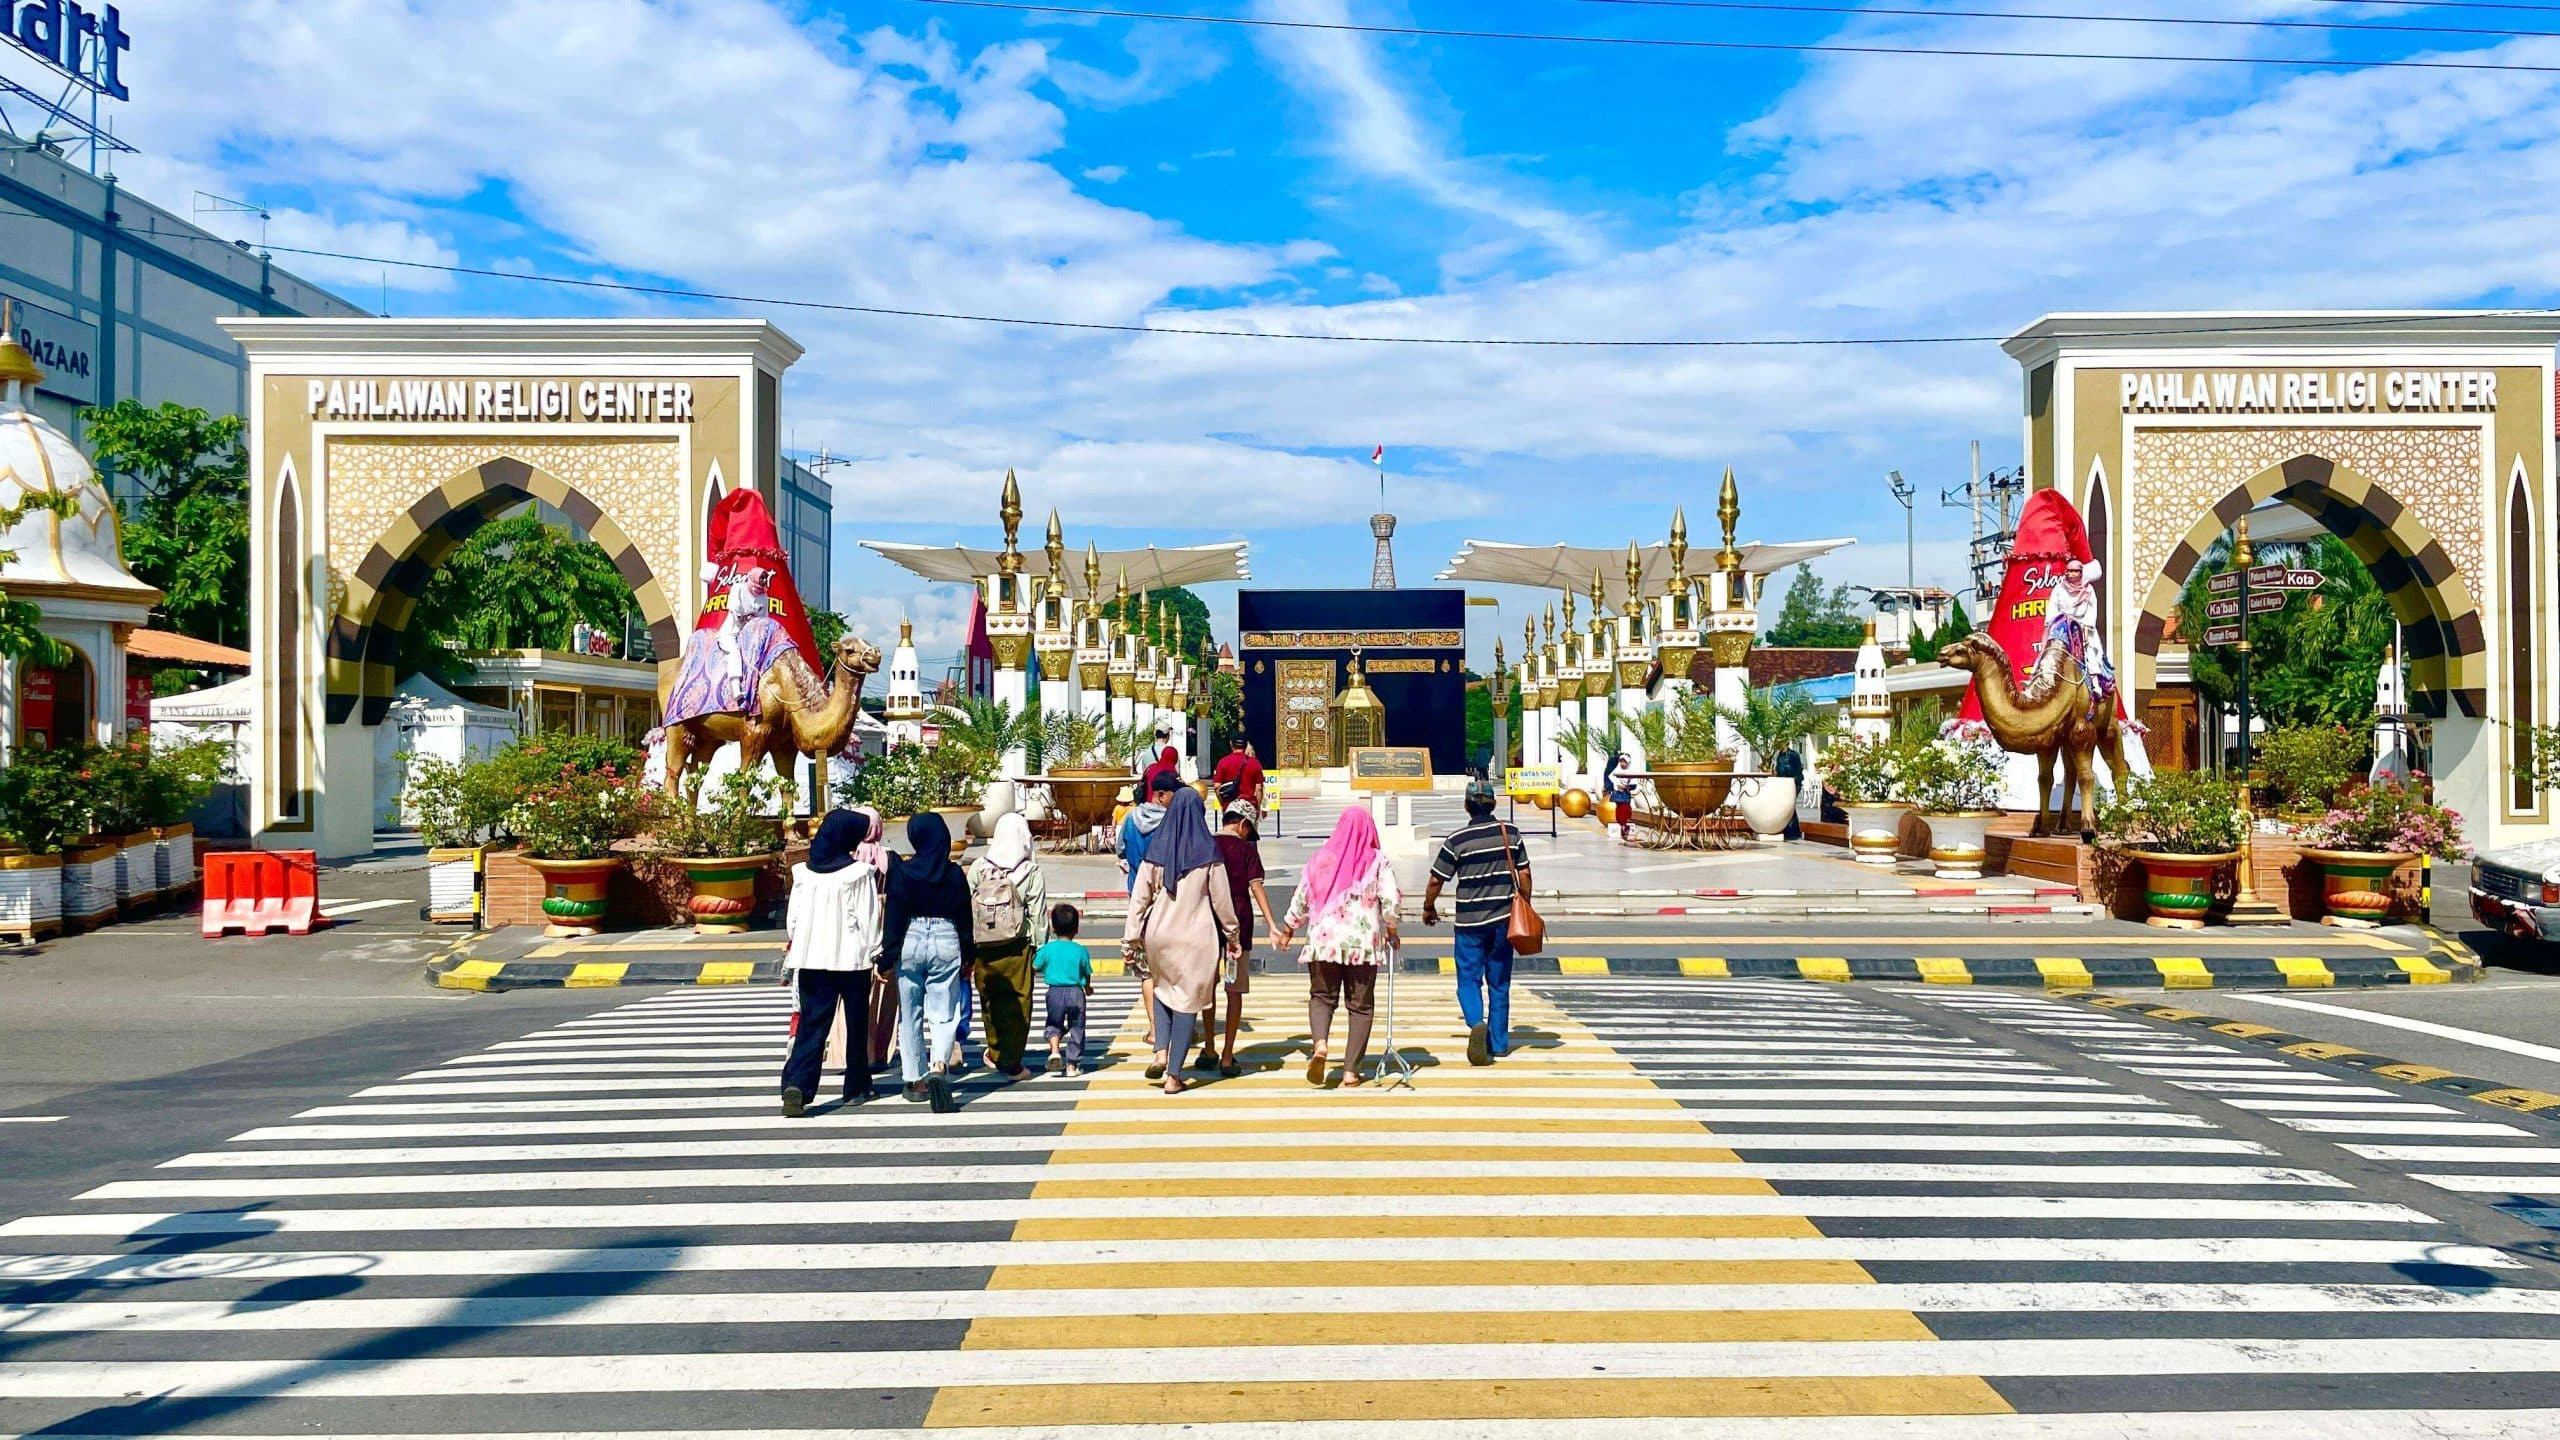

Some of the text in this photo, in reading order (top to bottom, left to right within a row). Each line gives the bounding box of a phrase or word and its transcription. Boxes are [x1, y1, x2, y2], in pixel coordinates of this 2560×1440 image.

[21, 329, 89, 379] BAZAAR
[307, 380, 694, 420] PAHLAWAN RELIGI CENTER
[2121, 372, 2498, 411] PAHLAWAN RELIGI CENTER
[2287, 572, 2315, 586] Kota
[2209, 600, 2239, 616] Ka'bah
[1263, 775, 1278, 784] UCI
